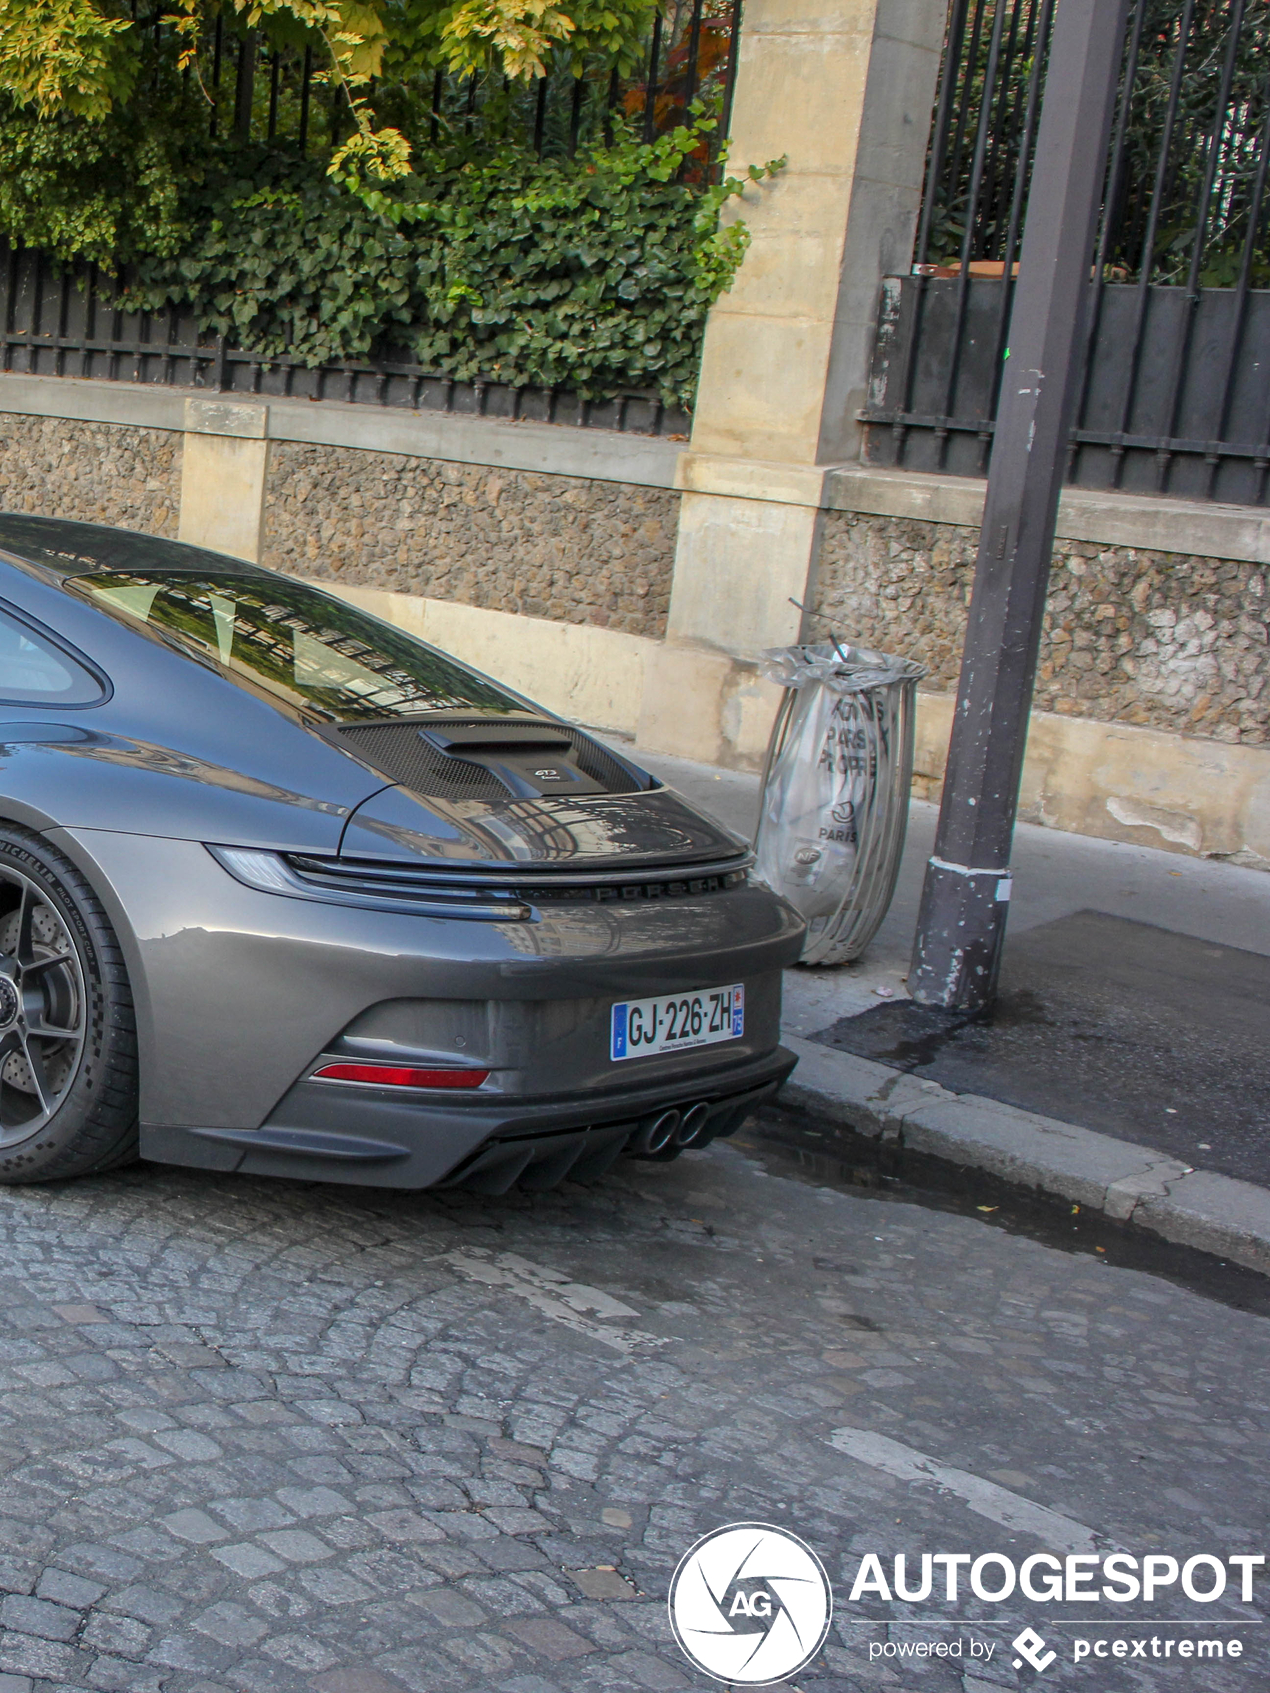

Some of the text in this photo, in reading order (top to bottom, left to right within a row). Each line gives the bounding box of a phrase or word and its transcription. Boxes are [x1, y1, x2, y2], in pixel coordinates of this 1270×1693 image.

[818, 828, 858, 843] PARIS
[797, 852, 819, 862] NF
[596, 871, 746, 900] PORSCHE
[56, 886, 74, 908] PILOT
[72, 910, 87, 938] SPORT
[84, 940, 94, 958] CUP
[616, 992, 742, 1048] F GJ-226-ZH 75
